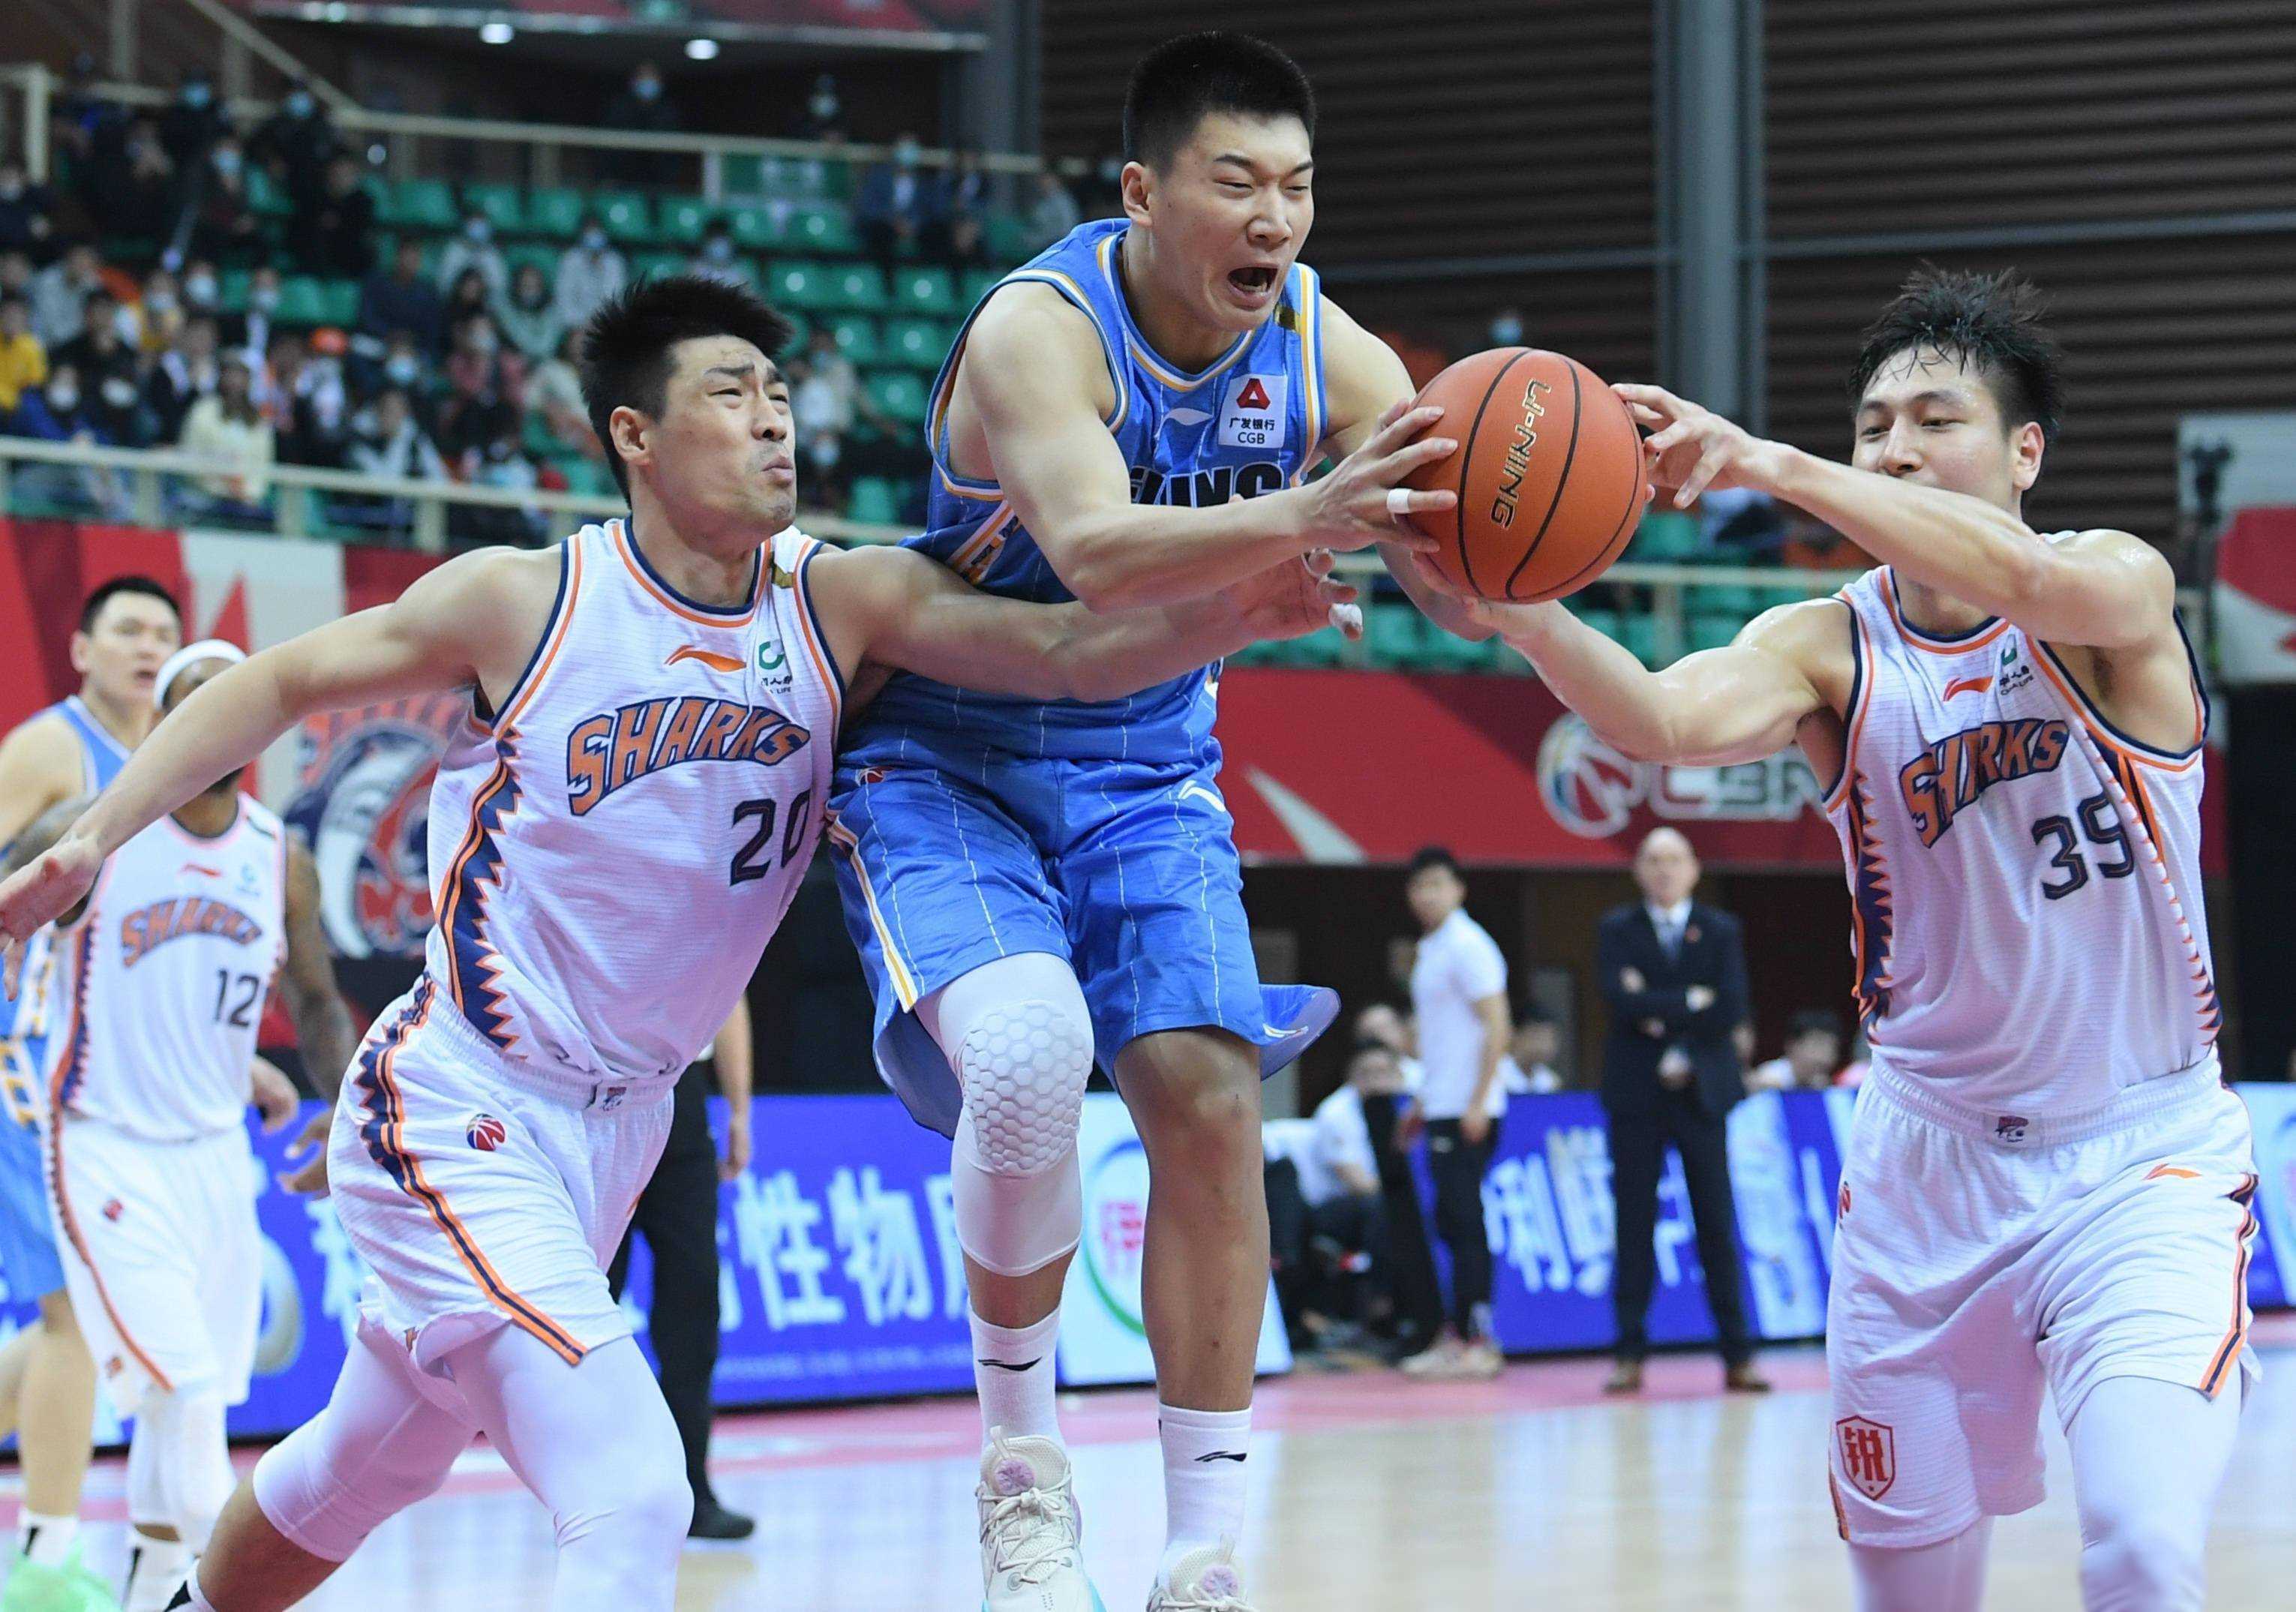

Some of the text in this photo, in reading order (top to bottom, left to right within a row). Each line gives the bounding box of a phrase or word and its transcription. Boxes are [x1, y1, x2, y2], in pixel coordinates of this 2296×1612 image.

[1229, 416, 1275, 431] 广发银行
[1238, 431, 1265, 445] CGB
[1490, 377, 1552, 530] LI-NING
[566, 696, 811, 816] SHARKS
[729, 789, 811, 887] 20
[2031, 794, 2135, 901] 39
[120, 896, 263, 968] SHARKS
[215, 968, 260, 1028] 12
